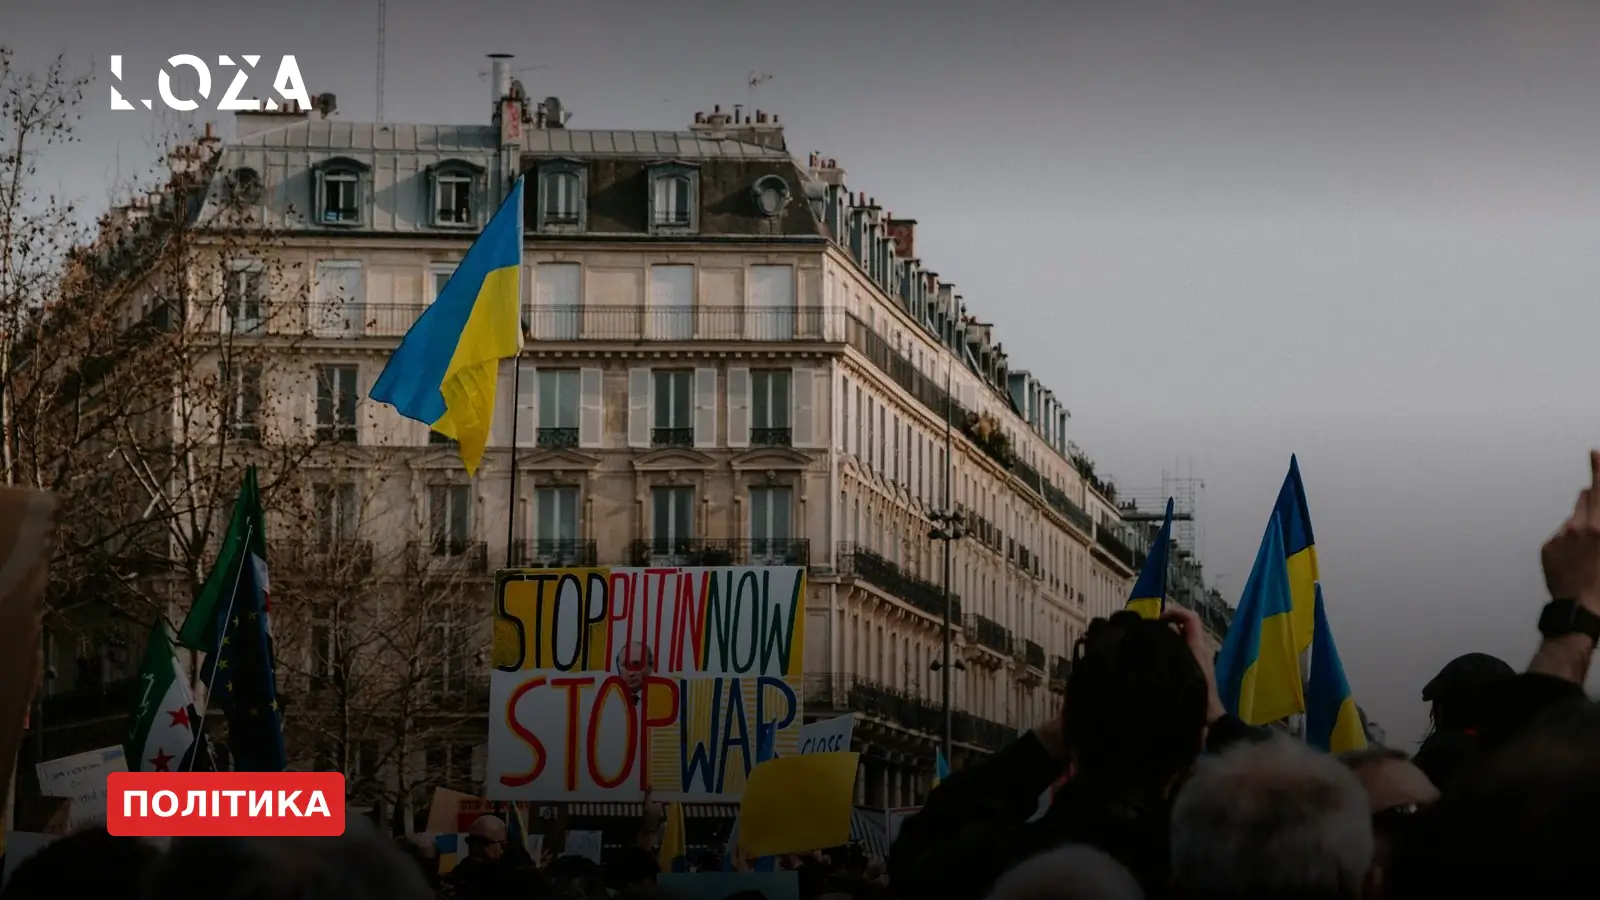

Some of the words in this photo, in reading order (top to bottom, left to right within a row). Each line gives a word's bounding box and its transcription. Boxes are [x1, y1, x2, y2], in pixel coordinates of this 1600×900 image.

[496, 571, 609, 672] STOP
[701, 569, 804, 675] NOW
[499, 675, 680, 792] STOP
[680, 676, 797, 794] WAR
